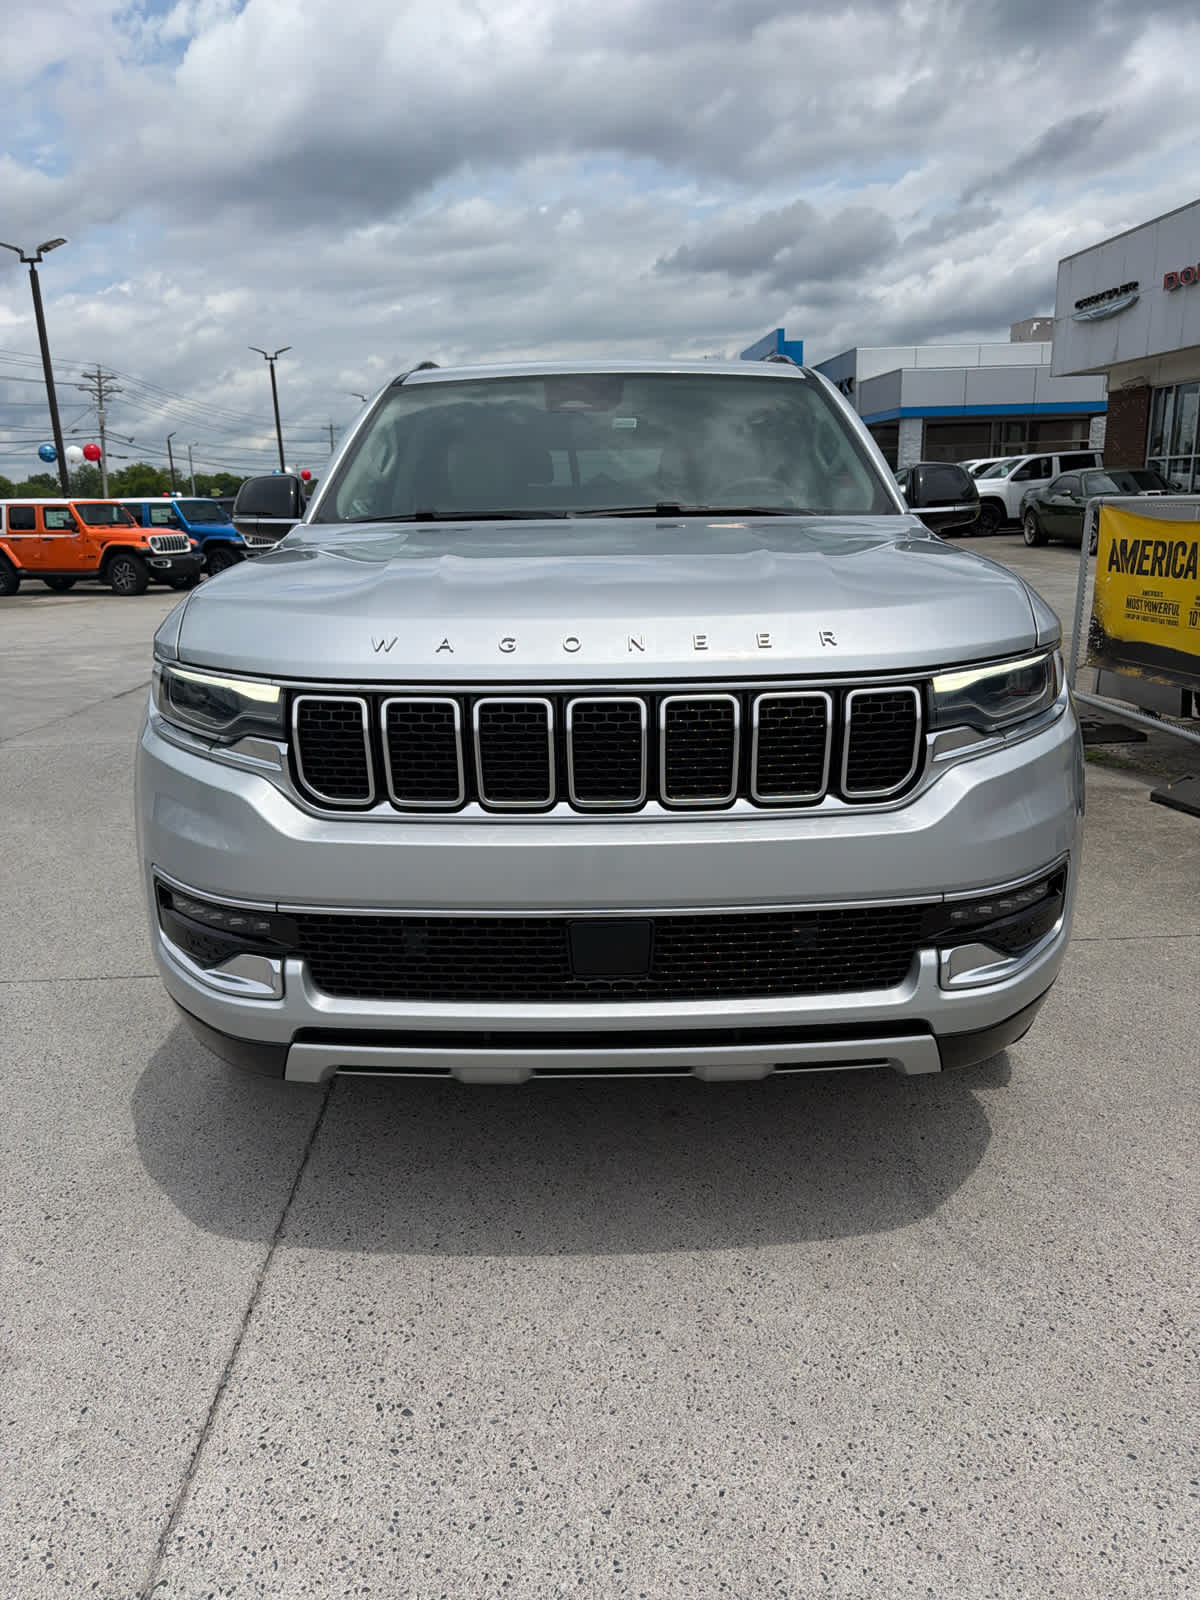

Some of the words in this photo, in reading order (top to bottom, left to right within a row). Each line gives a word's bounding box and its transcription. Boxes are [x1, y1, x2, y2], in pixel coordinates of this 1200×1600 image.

[1163, 263, 1200, 290] DO
[1107, 539, 1198, 580] AMERICA
[1126, 597, 1143, 611] MOST
[1143, 600, 1180, 617] POWERFUL
[370, 631, 838, 654] WAGONEER
